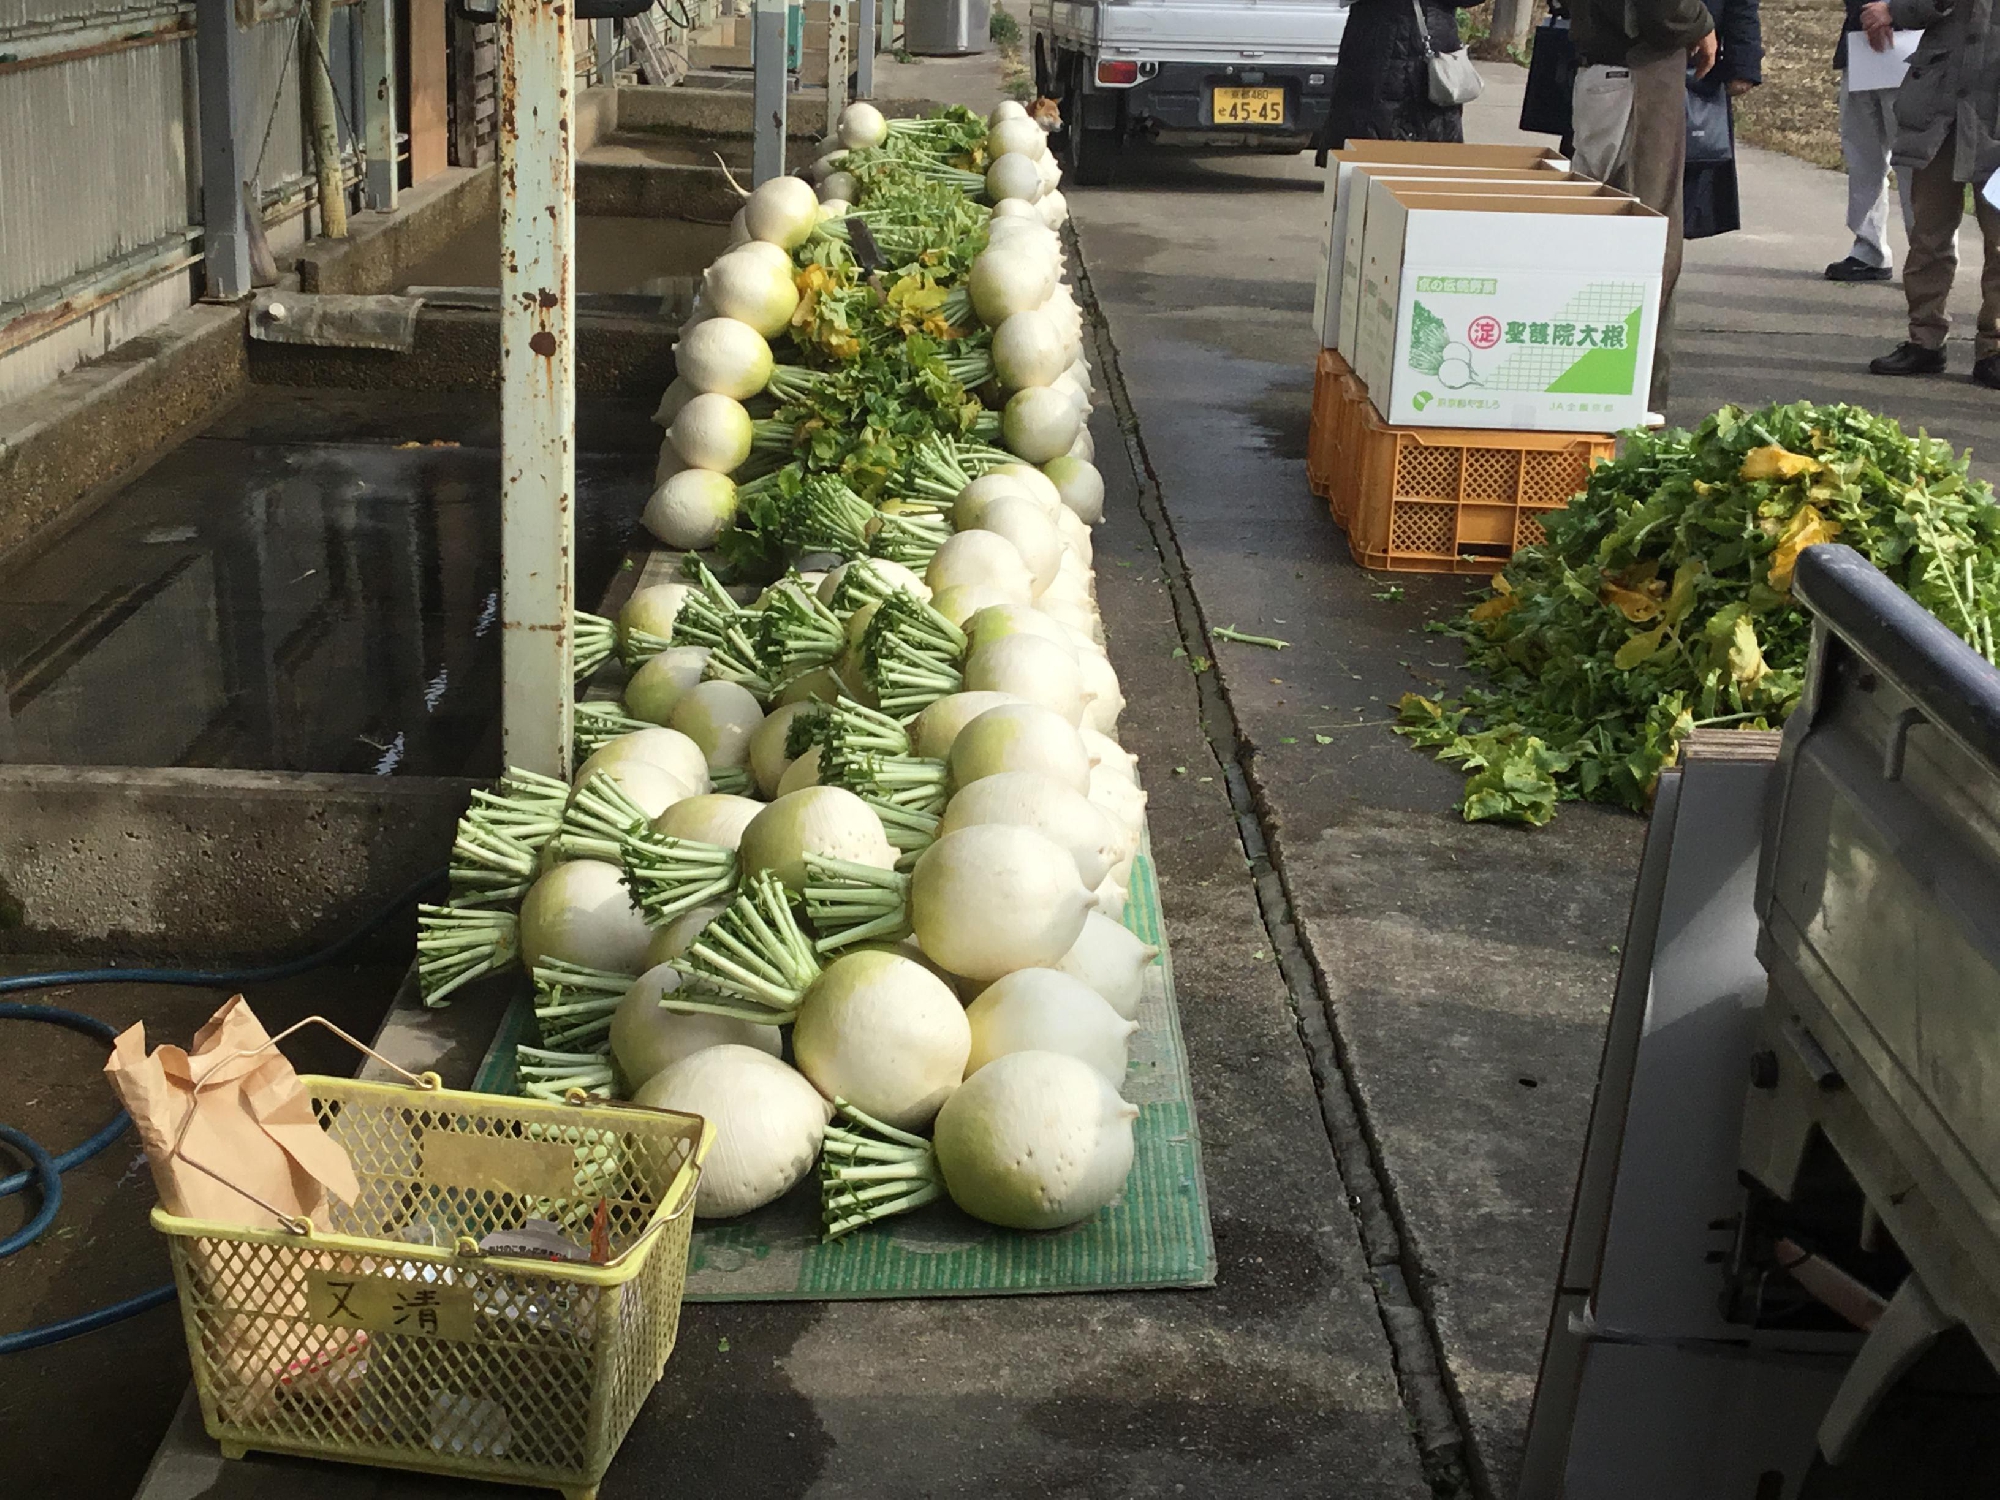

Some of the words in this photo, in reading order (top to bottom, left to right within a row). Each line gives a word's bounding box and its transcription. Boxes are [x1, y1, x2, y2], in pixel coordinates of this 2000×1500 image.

[1229, 102, 1281, 121] 45-45
[1472, 320, 1497, 345] 淀
[1504, 320, 1625, 348] 聖護院大根
